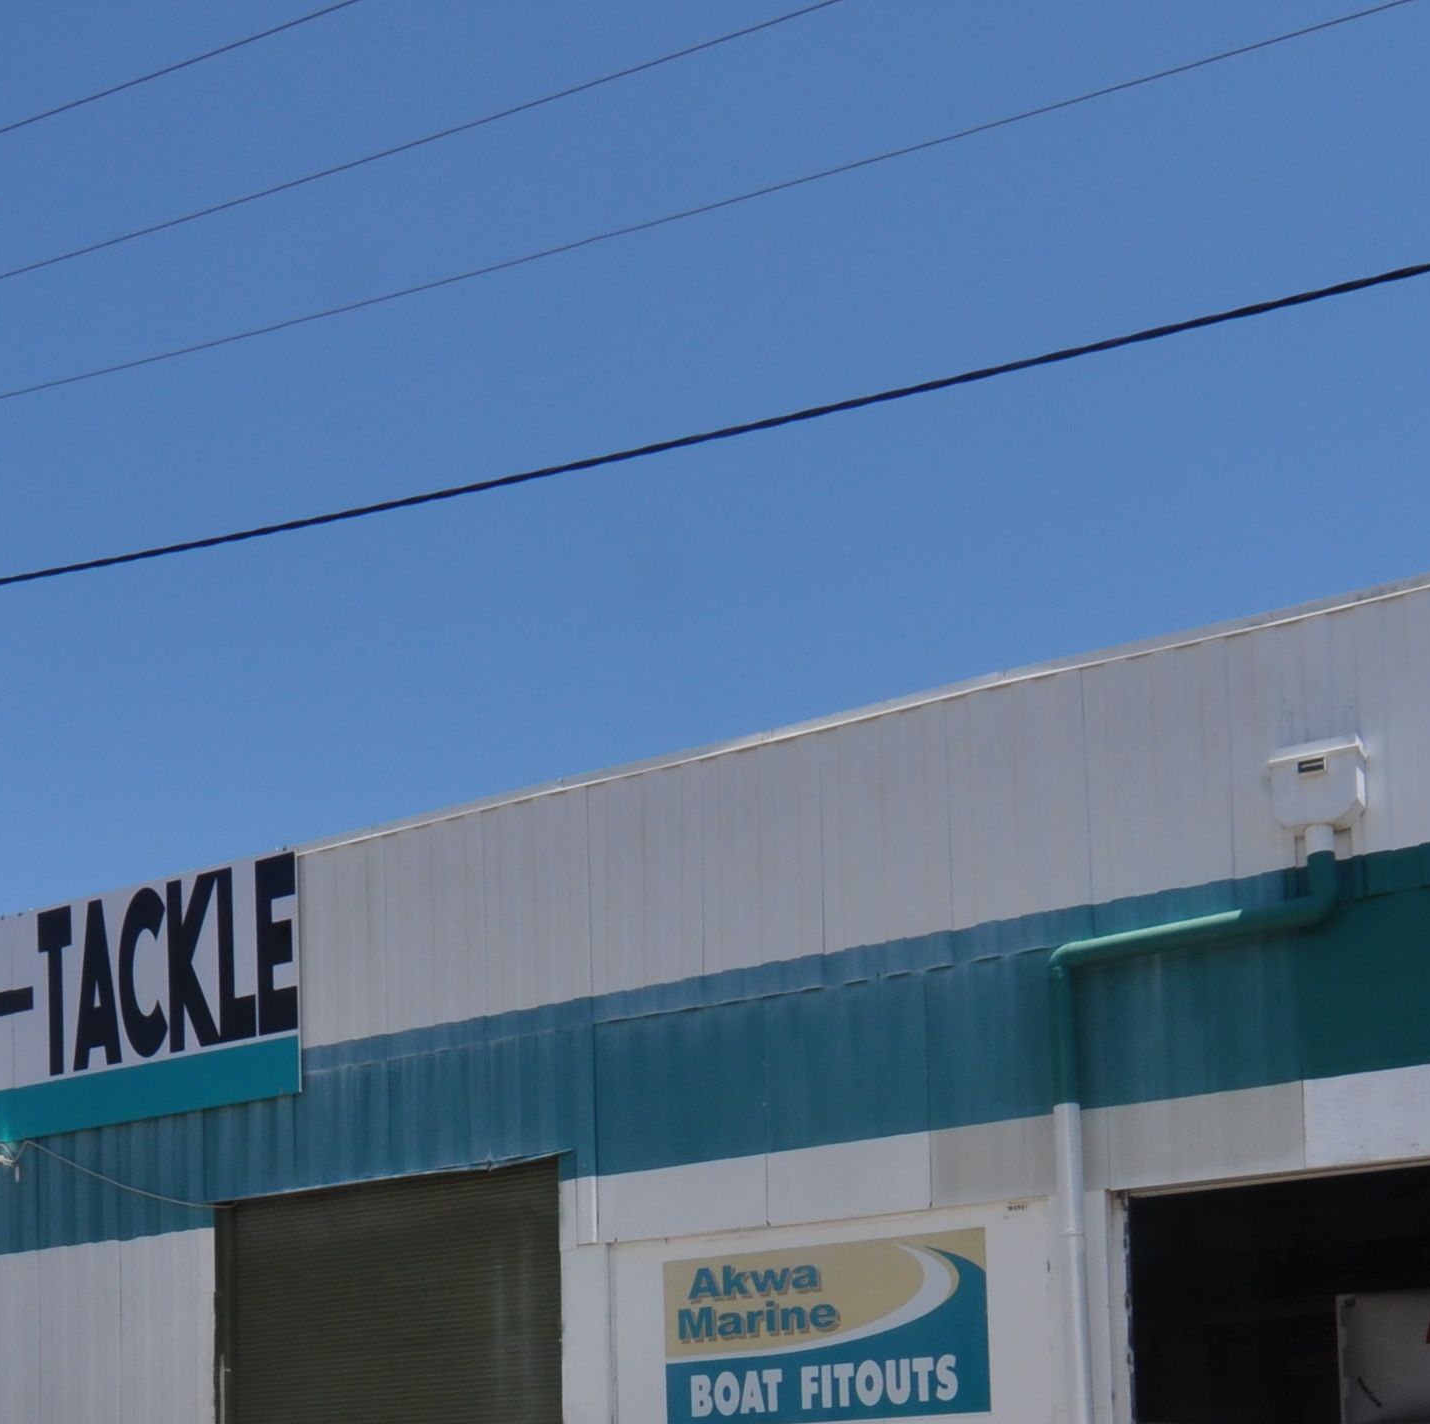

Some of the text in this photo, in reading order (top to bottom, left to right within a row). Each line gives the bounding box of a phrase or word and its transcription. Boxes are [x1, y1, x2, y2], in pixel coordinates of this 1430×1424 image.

[688, 1264, 821, 1301] Akwa
[678, 1301, 840, 1343] Marine
[690, 1354, 959, 1418] BOAT FITOUTS
